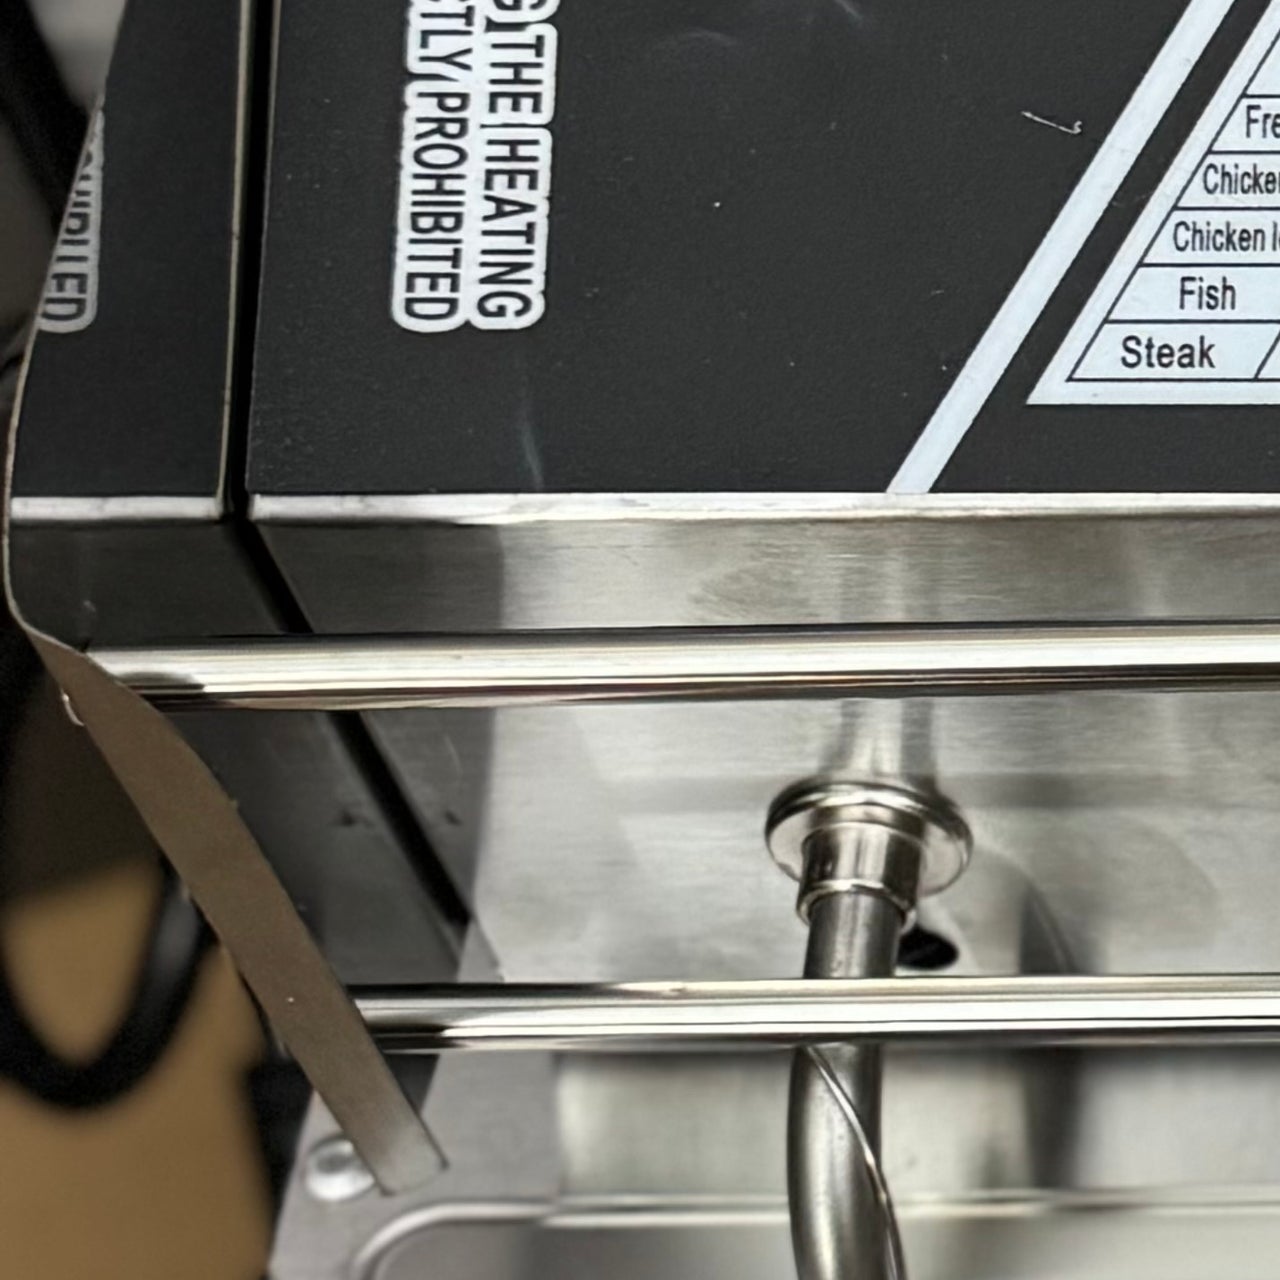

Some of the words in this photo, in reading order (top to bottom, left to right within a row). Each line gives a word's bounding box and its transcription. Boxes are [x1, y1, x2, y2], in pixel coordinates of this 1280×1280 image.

[487, 34, 546, 116] THE
[404, 91, 470, 321] PROHIBITED
[476, 139, 541, 318] HEATING
[1172, 220, 1266, 253] Chicken
[1178, 276, 1237, 311] Fish
[1120, 335, 1216, 370] Steak
